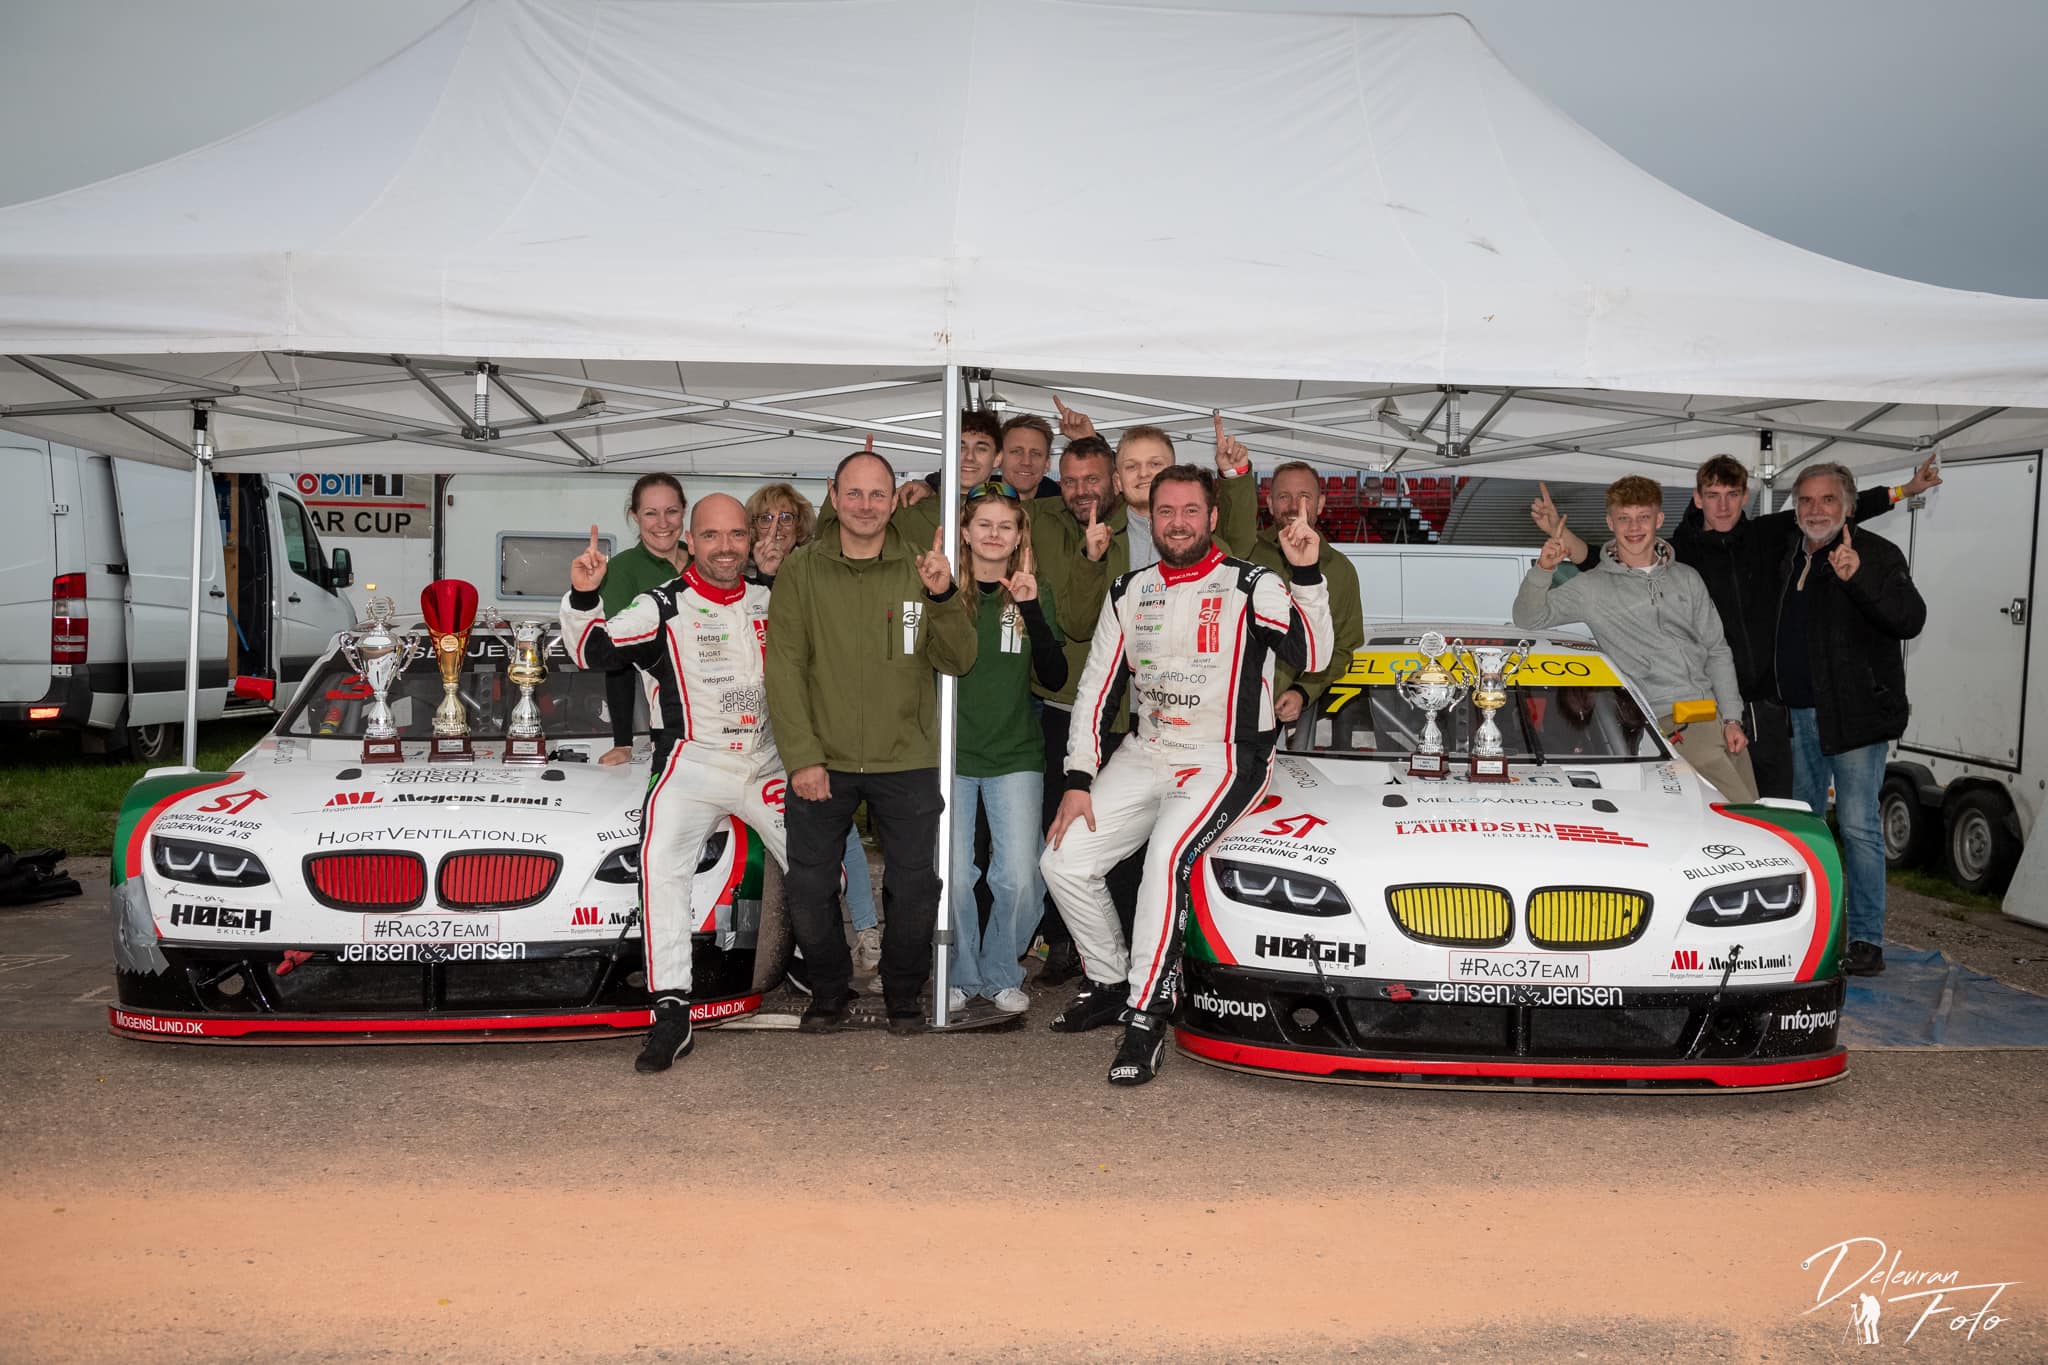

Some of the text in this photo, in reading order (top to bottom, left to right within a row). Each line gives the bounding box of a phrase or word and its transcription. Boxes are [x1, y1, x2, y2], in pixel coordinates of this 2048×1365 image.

[354, 511, 412, 533] CUP
[697, 634, 720, 642] Hetag
[1326, 687, 1362, 713] 7
[227, 829, 252, 840] A/S
[596, 826, 641, 842] BILLU
[1396, 821, 1551, 836] LAURIDSEN
[317, 827, 548, 846] HJORTVENTILATION.DK
[1303, 854, 1329, 866] A/S
[1682, 861, 1745, 881] BILLUND
[1758, 955, 1786, 969] Lund
